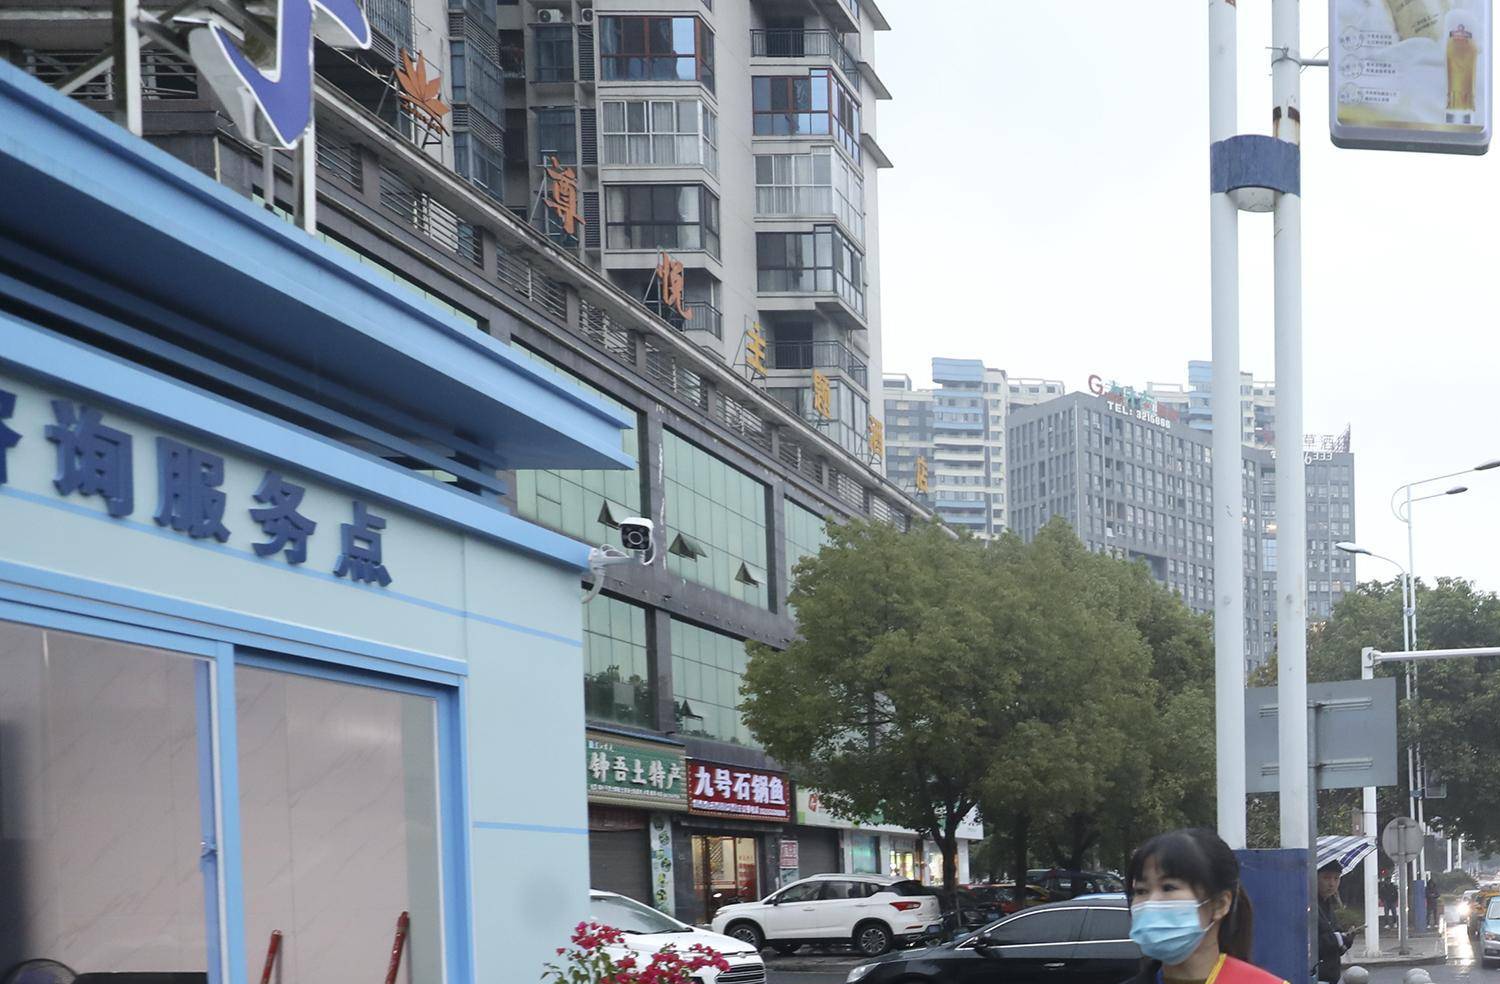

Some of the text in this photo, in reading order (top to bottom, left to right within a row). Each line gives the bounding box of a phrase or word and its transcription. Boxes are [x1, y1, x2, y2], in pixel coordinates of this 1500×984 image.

[0, 390, 392, 587] 询服务点
[694, 765, 786, 805] 九号石锅鱼
